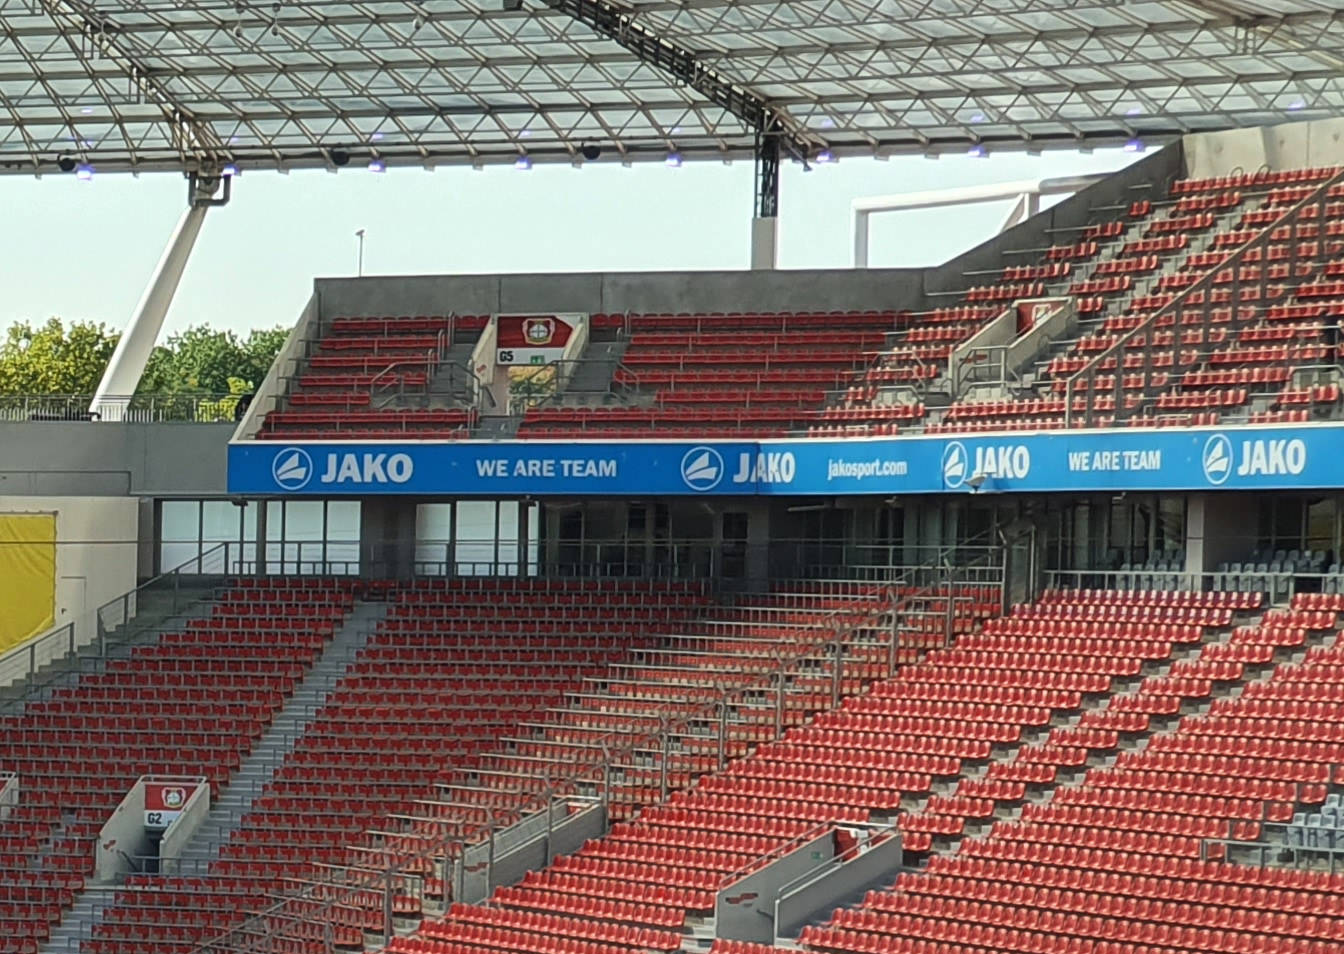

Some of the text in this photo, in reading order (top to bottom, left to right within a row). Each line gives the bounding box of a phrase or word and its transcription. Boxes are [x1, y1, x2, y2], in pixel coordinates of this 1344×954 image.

[321, 453, 413, 483] JAKO
[476, 459, 616, 477] WE ARE TEAM
[733, 452, 796, 483] JAKO
[828, 458, 908, 480] jakosport.com
[972, 445, 1030, 479] JAKO
[1069, 450, 1160, 471] WE ARE TEAM
[1238, 439, 1306, 475] JAKO
[147, 812, 162, 825] G2
